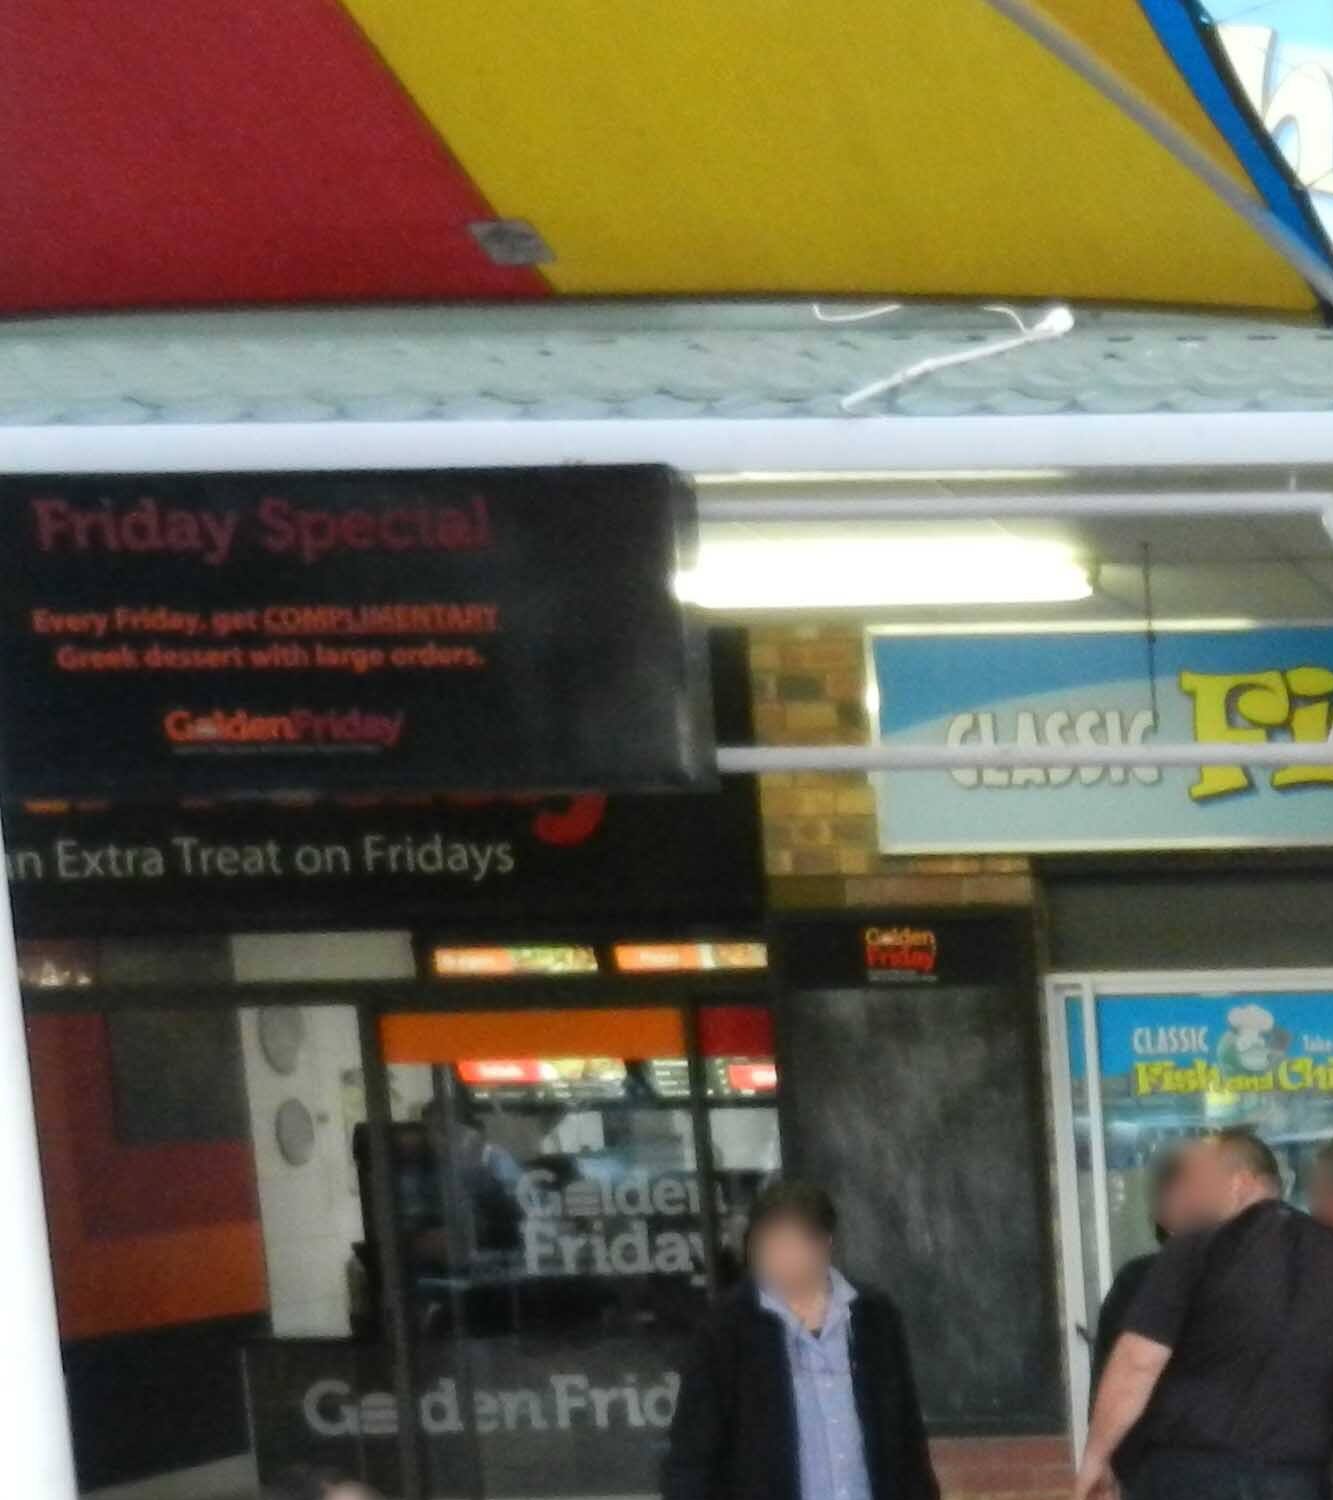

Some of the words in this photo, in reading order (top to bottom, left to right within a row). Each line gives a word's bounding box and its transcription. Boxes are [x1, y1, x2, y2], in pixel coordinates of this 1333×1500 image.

[30, 496, 241, 565] Friday
[258, 497, 491, 564] Special
[31, 607, 109, 637] Every
[212, 609, 258, 636] get
[263, 602, 498, 635] COMPLIMENTARY
[56, 646, 137, 671] Greek
[144, 645, 244, 670] dessert
[248, 644, 308, 669] with
[315, 643, 385, 674] large
[56, 839, 166, 880] Extra
[173, 834, 284, 878] Treat
[294, 847, 351, 876] on
[363, 834, 516, 881] Fridays
[1132, 1026, 1209, 1055] CLASSIC
[1133, 1058, 1222, 1096] Fish
[1223, 1072, 1274, 1093] and
